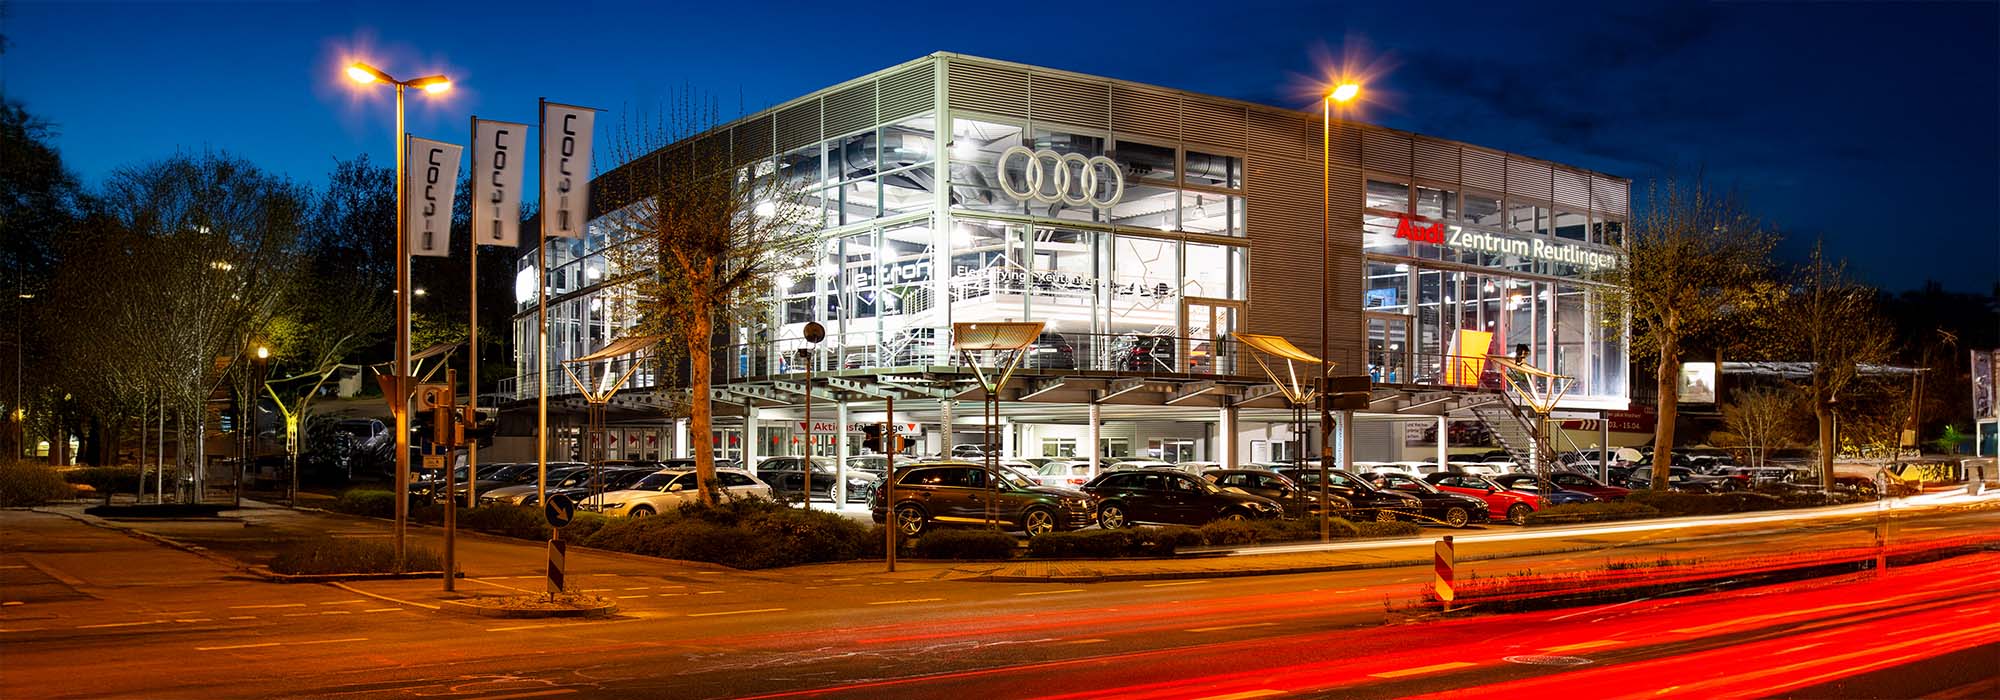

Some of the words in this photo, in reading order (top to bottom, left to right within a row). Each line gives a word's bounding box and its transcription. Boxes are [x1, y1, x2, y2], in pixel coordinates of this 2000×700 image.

[1396, 217, 1444, 243] Audi
[1449, 226, 1529, 256] Zentrum
[1533, 239, 1616, 271] Reutlingen
[855, 262, 932, 289] e-tron
[957, 265, 1027, 283] Eleying
[814, 422, 904, 433] Aktisfaege
